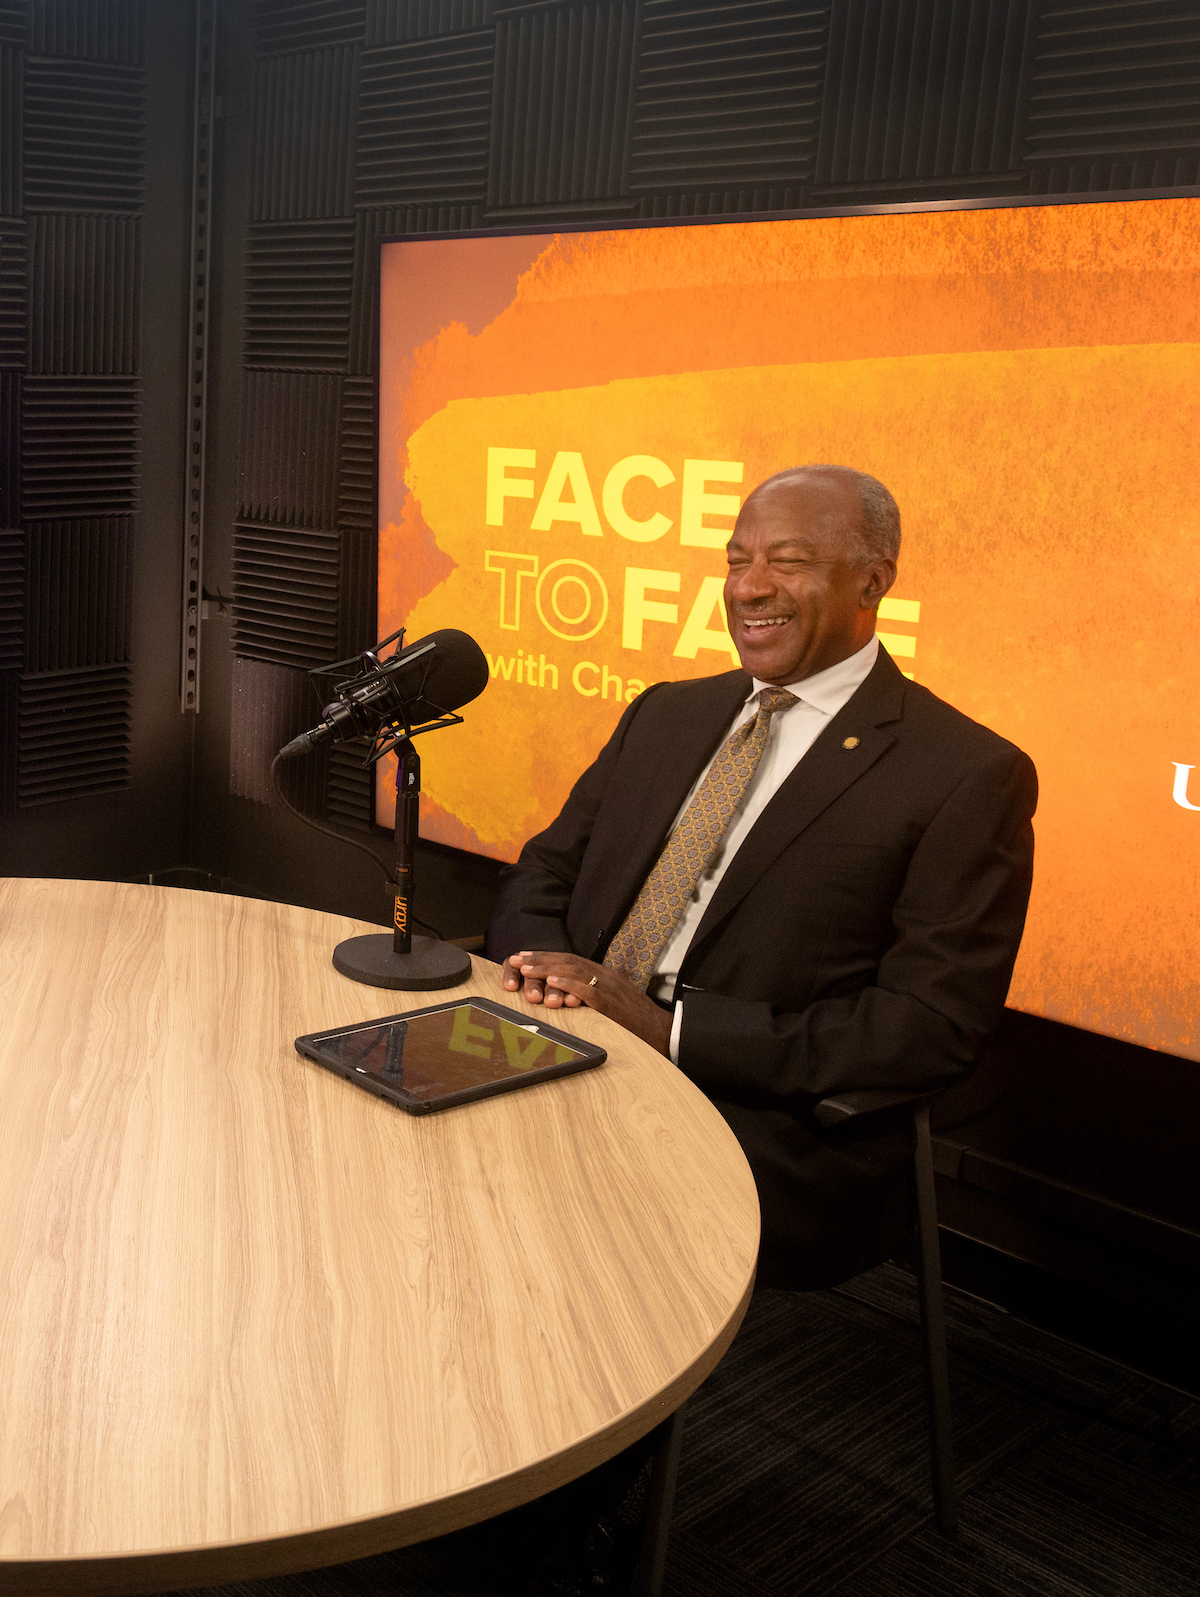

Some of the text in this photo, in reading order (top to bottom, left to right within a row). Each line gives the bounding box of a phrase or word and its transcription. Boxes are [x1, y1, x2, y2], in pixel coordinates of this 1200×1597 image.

[486, 447, 743, 549] FACE
[485, 550, 920, 681] TO FA
[487, 649, 657, 704] with Cha
[394, 895, 408, 933] uray
